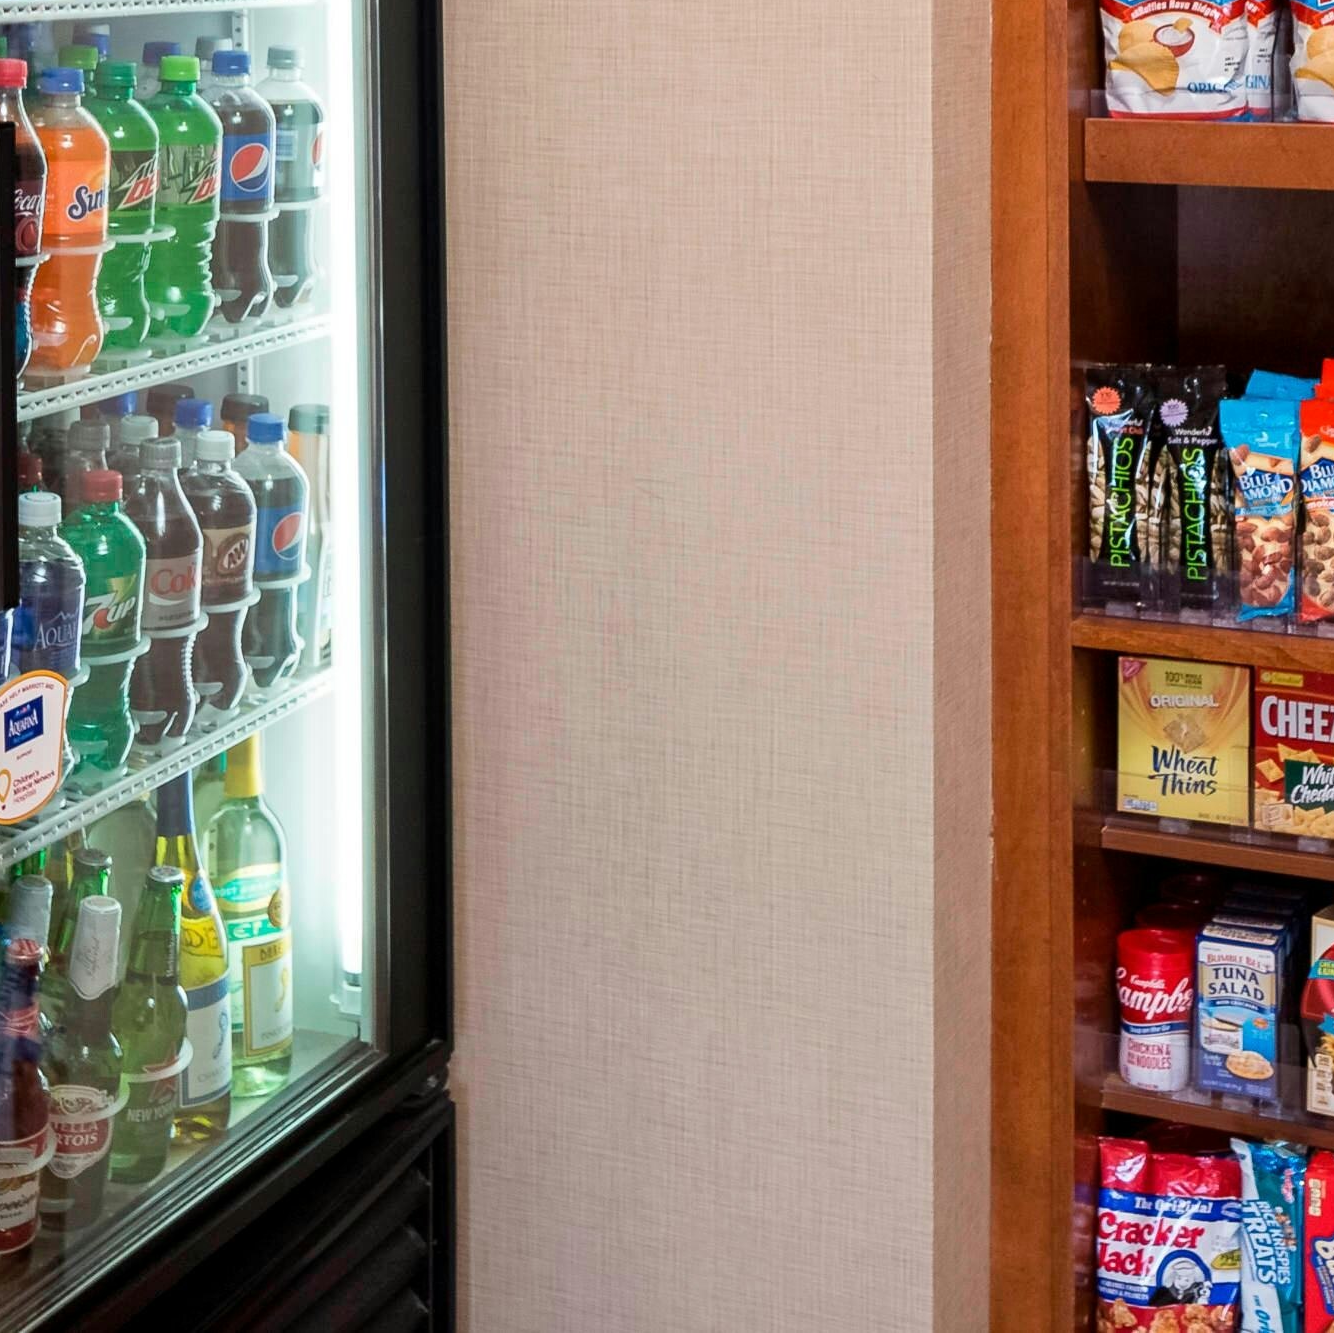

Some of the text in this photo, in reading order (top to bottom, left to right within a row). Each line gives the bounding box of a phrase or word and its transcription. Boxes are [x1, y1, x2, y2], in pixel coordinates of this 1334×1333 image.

[1111, 437, 1134, 567] PISTACHIOS
[1150, 695, 1219, 709] ORIGINAL
[9, 708, 39, 737] AQUAFINA
[1151, 745, 1218, 777] Wheat
[1147, 773, 1218, 796] Thins
[1207, 954, 1242, 964] BUMBLE
[1212, 967, 1260, 985] TUNA
[1208, 982, 1264, 1001] SALAD
[1128, 1039, 1162, 1055] CHICKEN
[1137, 1057, 1171, 1070] NOODLES
[56, 1133, 98, 1146] RTOIS
[1134, 1198, 1214, 1214] The Original
[1099, 1212, 1205, 1249] Cracker
[1241, 1200, 1277, 1285] TREATS
